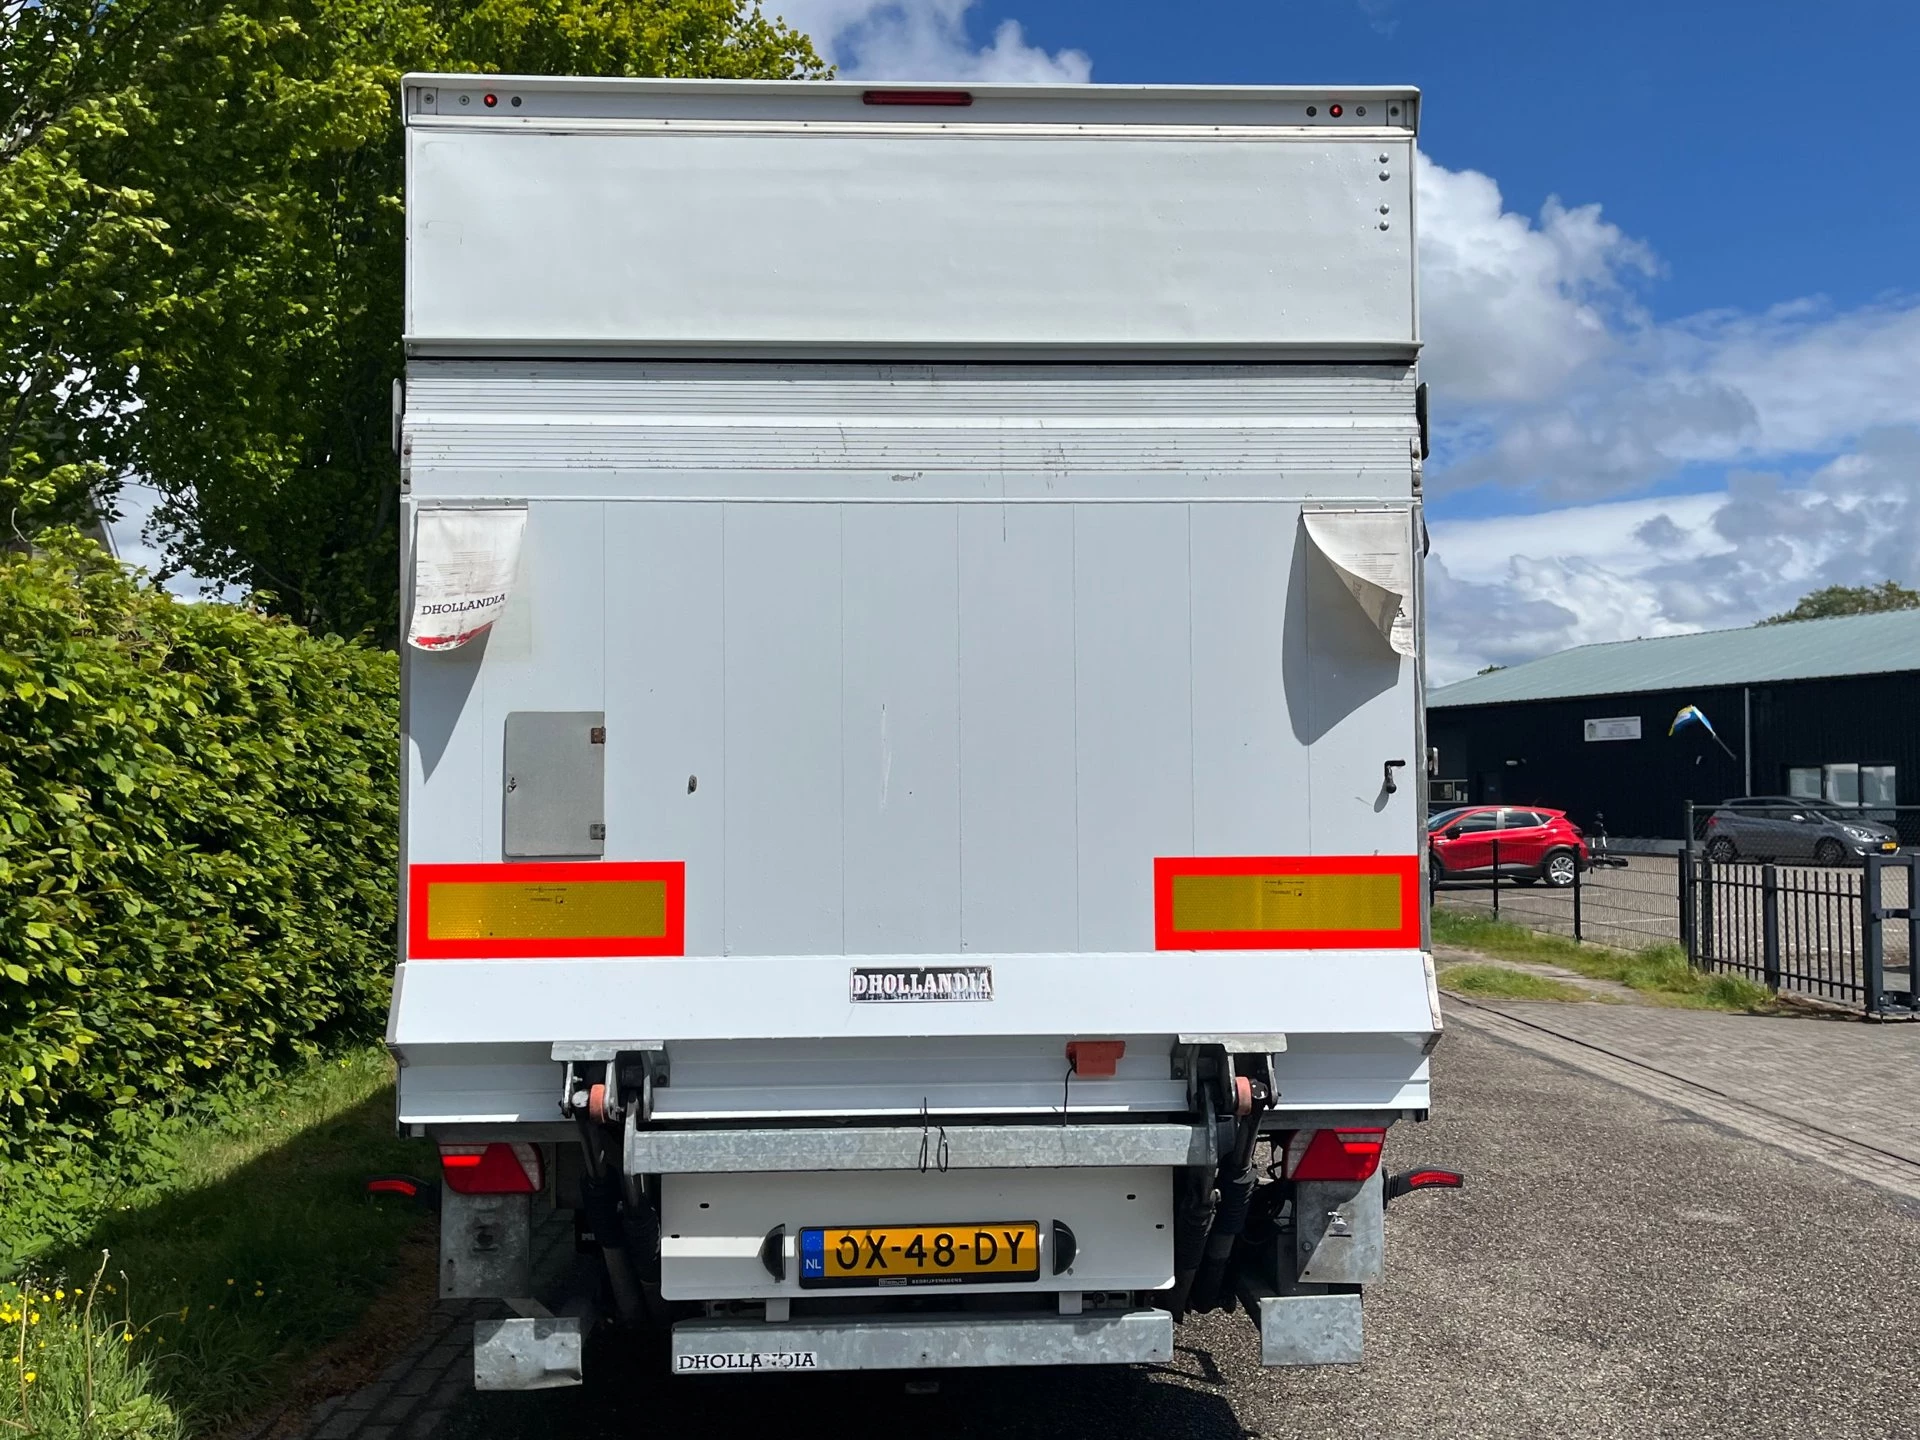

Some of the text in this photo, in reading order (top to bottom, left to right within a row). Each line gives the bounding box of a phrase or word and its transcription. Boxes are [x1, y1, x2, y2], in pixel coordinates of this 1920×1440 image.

[421, 593, 506, 615] DHOLLANDIA
[853, 972, 991, 994] DHOLLANDIA
[836, 1231, 1024, 1270] OX-48-DY
[806, 1259, 822, 1270] NL
[678, 1353, 816, 1370] DHOLLADIA
